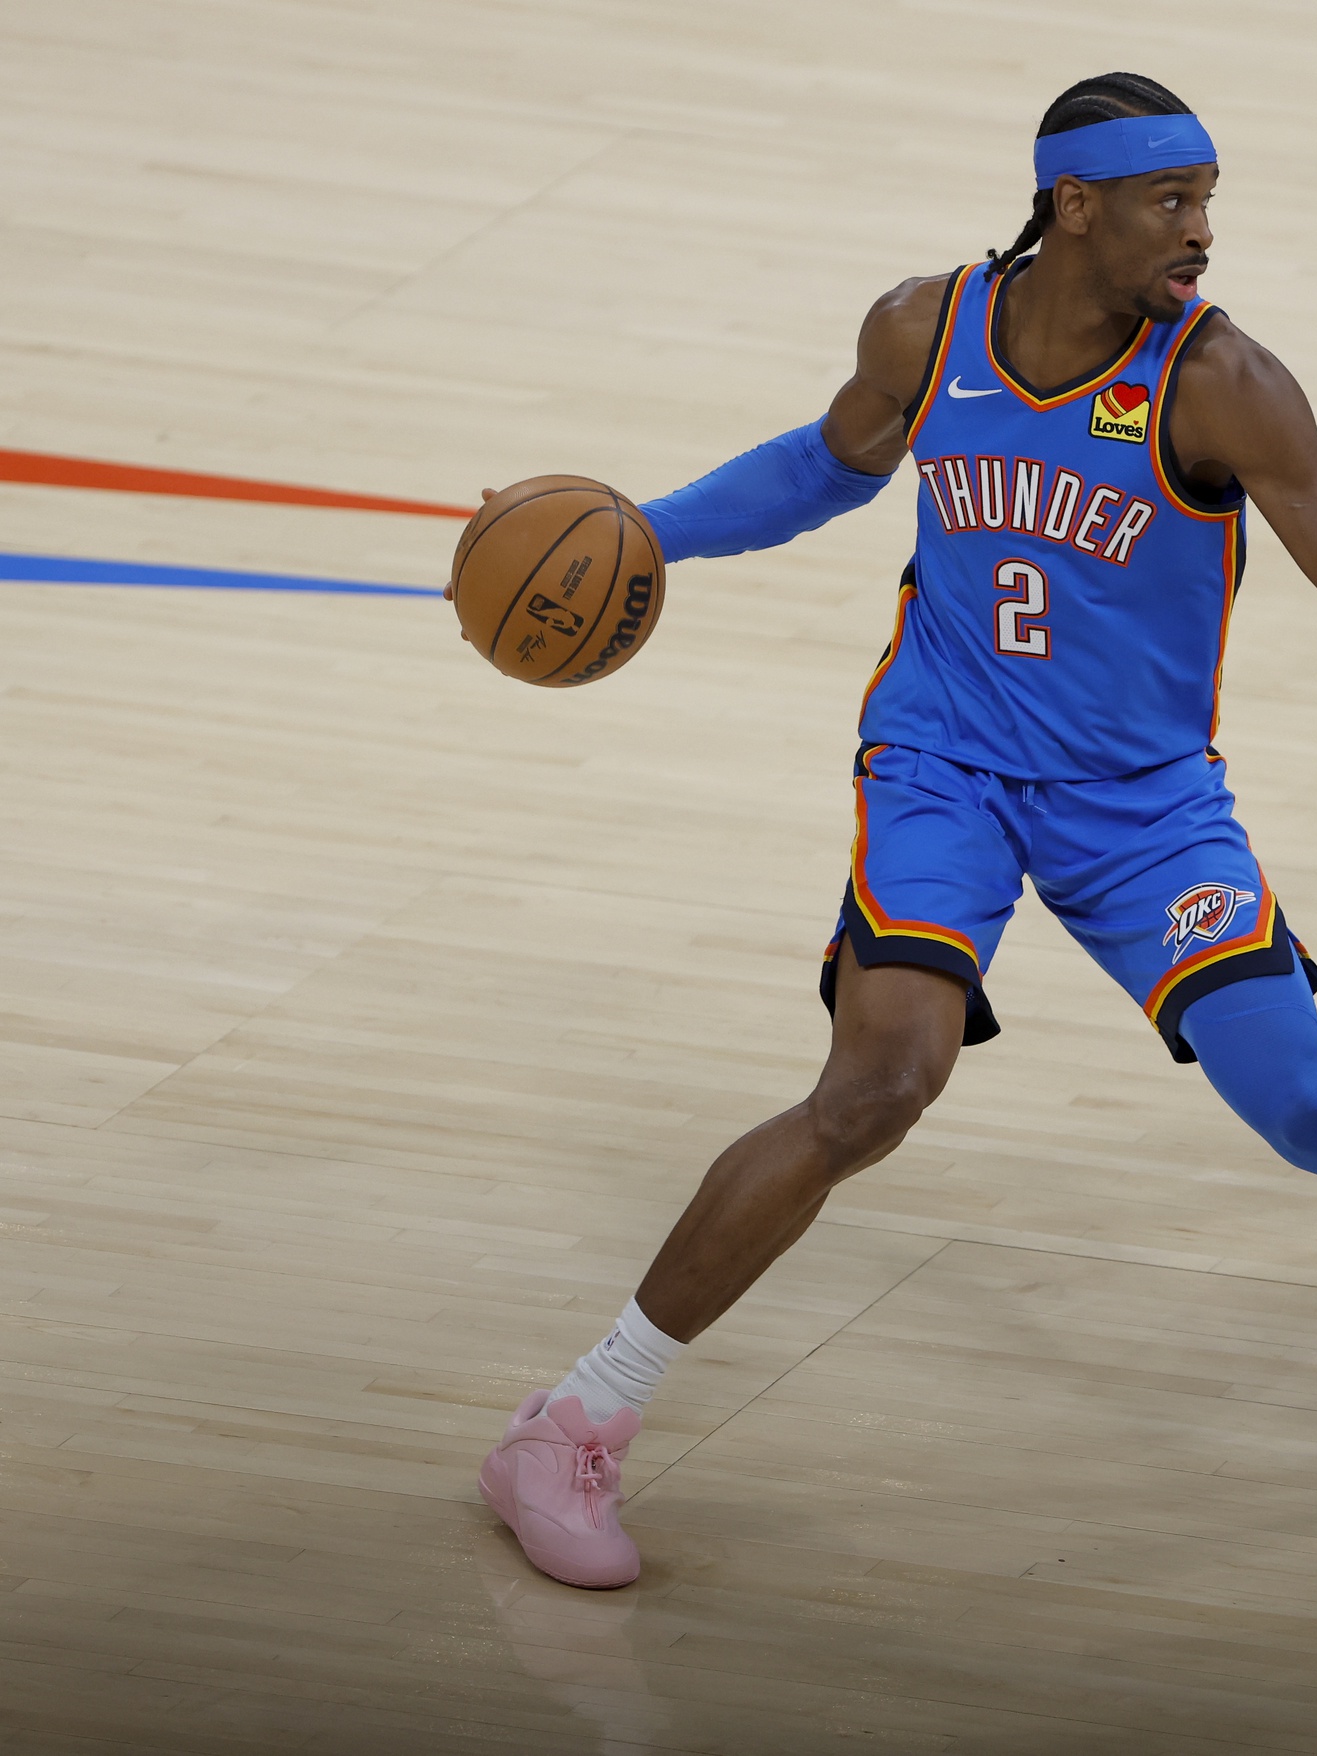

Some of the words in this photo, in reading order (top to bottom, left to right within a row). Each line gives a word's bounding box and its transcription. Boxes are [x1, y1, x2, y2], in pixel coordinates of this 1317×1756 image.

[917, 454, 1158, 568] THUNDER
[993, 557, 1051, 660] 2
[1177, 890, 1222, 945] OKC
